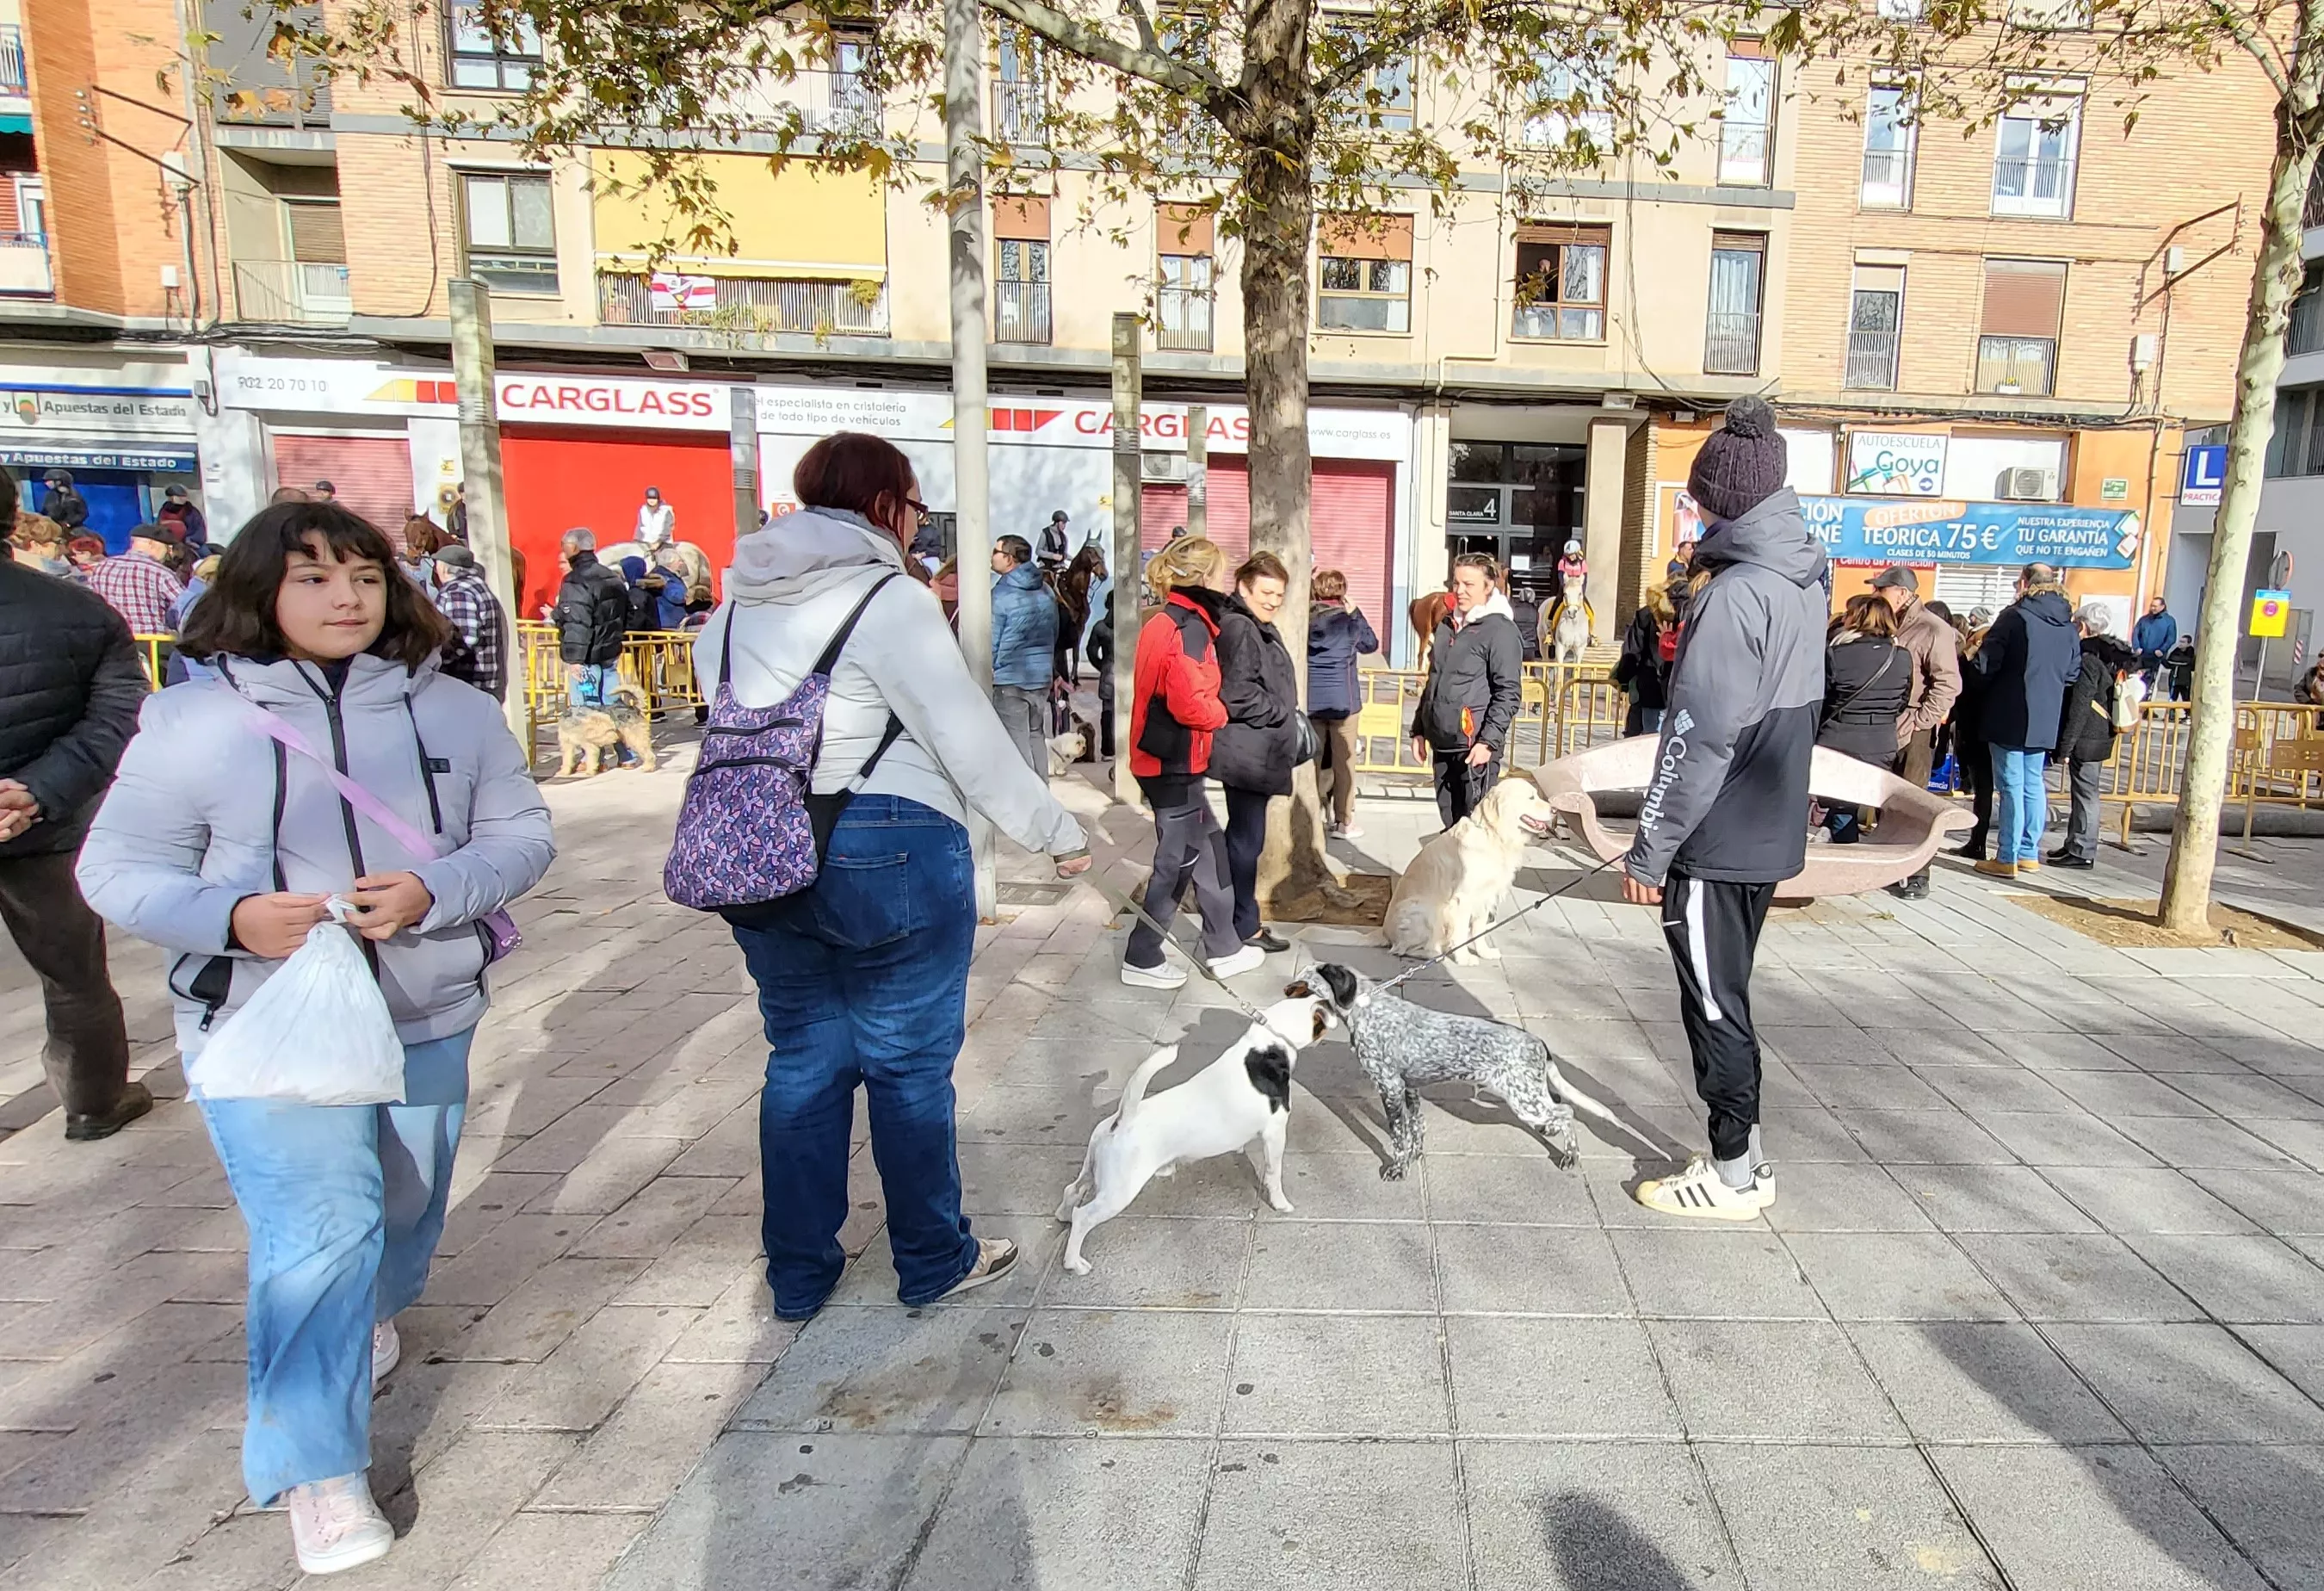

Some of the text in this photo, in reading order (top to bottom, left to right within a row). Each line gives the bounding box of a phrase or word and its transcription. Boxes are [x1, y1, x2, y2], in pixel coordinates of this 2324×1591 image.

[268, 378, 285, 390] 20
[289, 379, 306, 391] 70
[311, 380, 327, 392] 10
[502, 384, 713, 417] CARGLASS
[766, 398, 833, 410] especialista
[3, 400, 187, 417] y Apuestas del Estado
[761, 410, 775, 420] de
[778, 412, 804, 422] todo
[807, 413, 827, 423] tipo
[831, 413, 845, 423] de
[1857, 435, 1941, 449] AUTOESCUELA
[13, 452, 88, 466] Apuestas
[93, 455, 116, 466] del
[122, 456, 176, 468] Estado
[1876, 450, 1939, 477] Goya
[2196, 450, 2220, 486] L
[2183, 492, 2218, 501] PRACTIC
[1484, 498, 1496, 517] 4
[1800, 497, 1844, 522] IÓN
[2018, 517, 2110, 529] NUESTRA EXPERIENCIA
[2017, 528, 2108, 545] TU GARANTÍA
[1887, 548, 1914, 557] CLASES
[1915, 549, 1926, 558] DE
[2015, 544, 2035, 555] QUE
[2037, 545, 2050, 555] NO
[2053, 546, 2063, 555] TE
